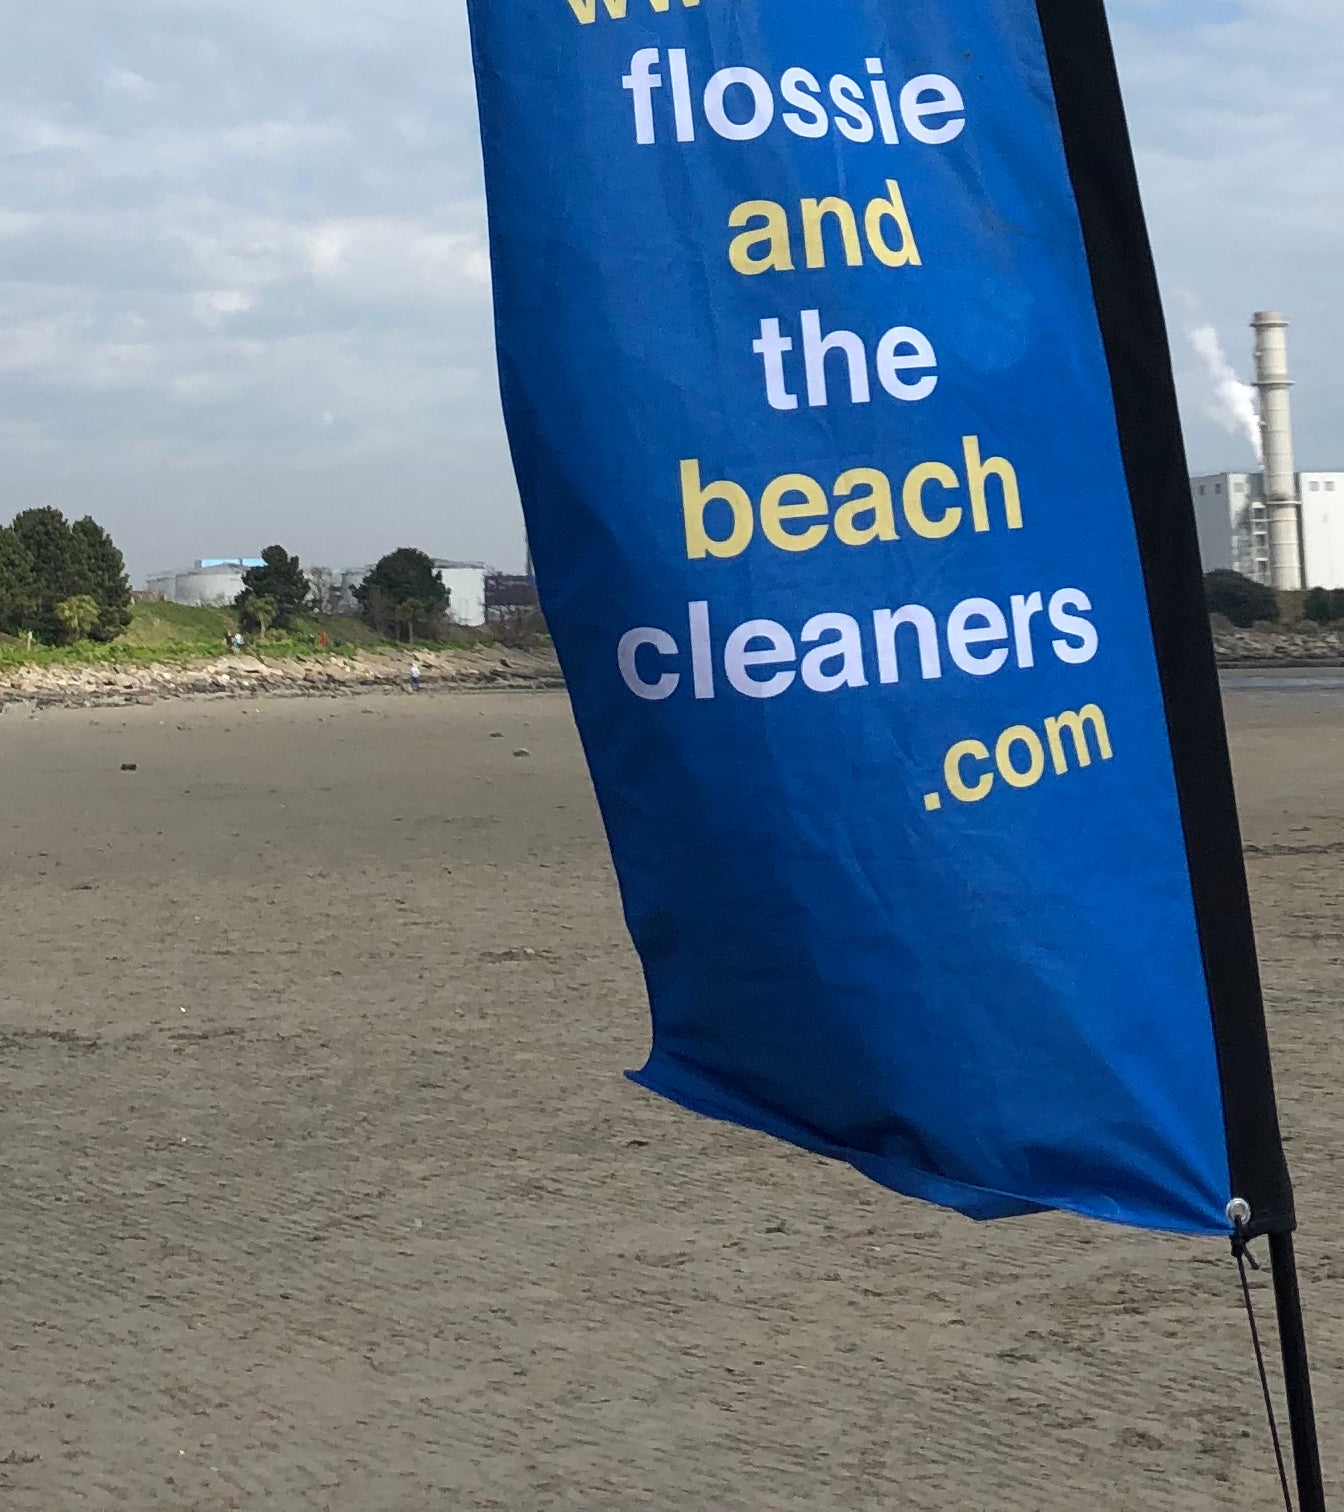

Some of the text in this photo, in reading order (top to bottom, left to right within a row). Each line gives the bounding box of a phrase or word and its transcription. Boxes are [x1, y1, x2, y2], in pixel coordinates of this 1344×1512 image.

[621, 48, 965, 145] flossie
[728, 179, 922, 275] and
[752, 309, 938, 410] the
[680, 435, 1023, 559] beach
[617, 587, 1099, 701] cleaners
[924, 703, 1113, 811] .com
